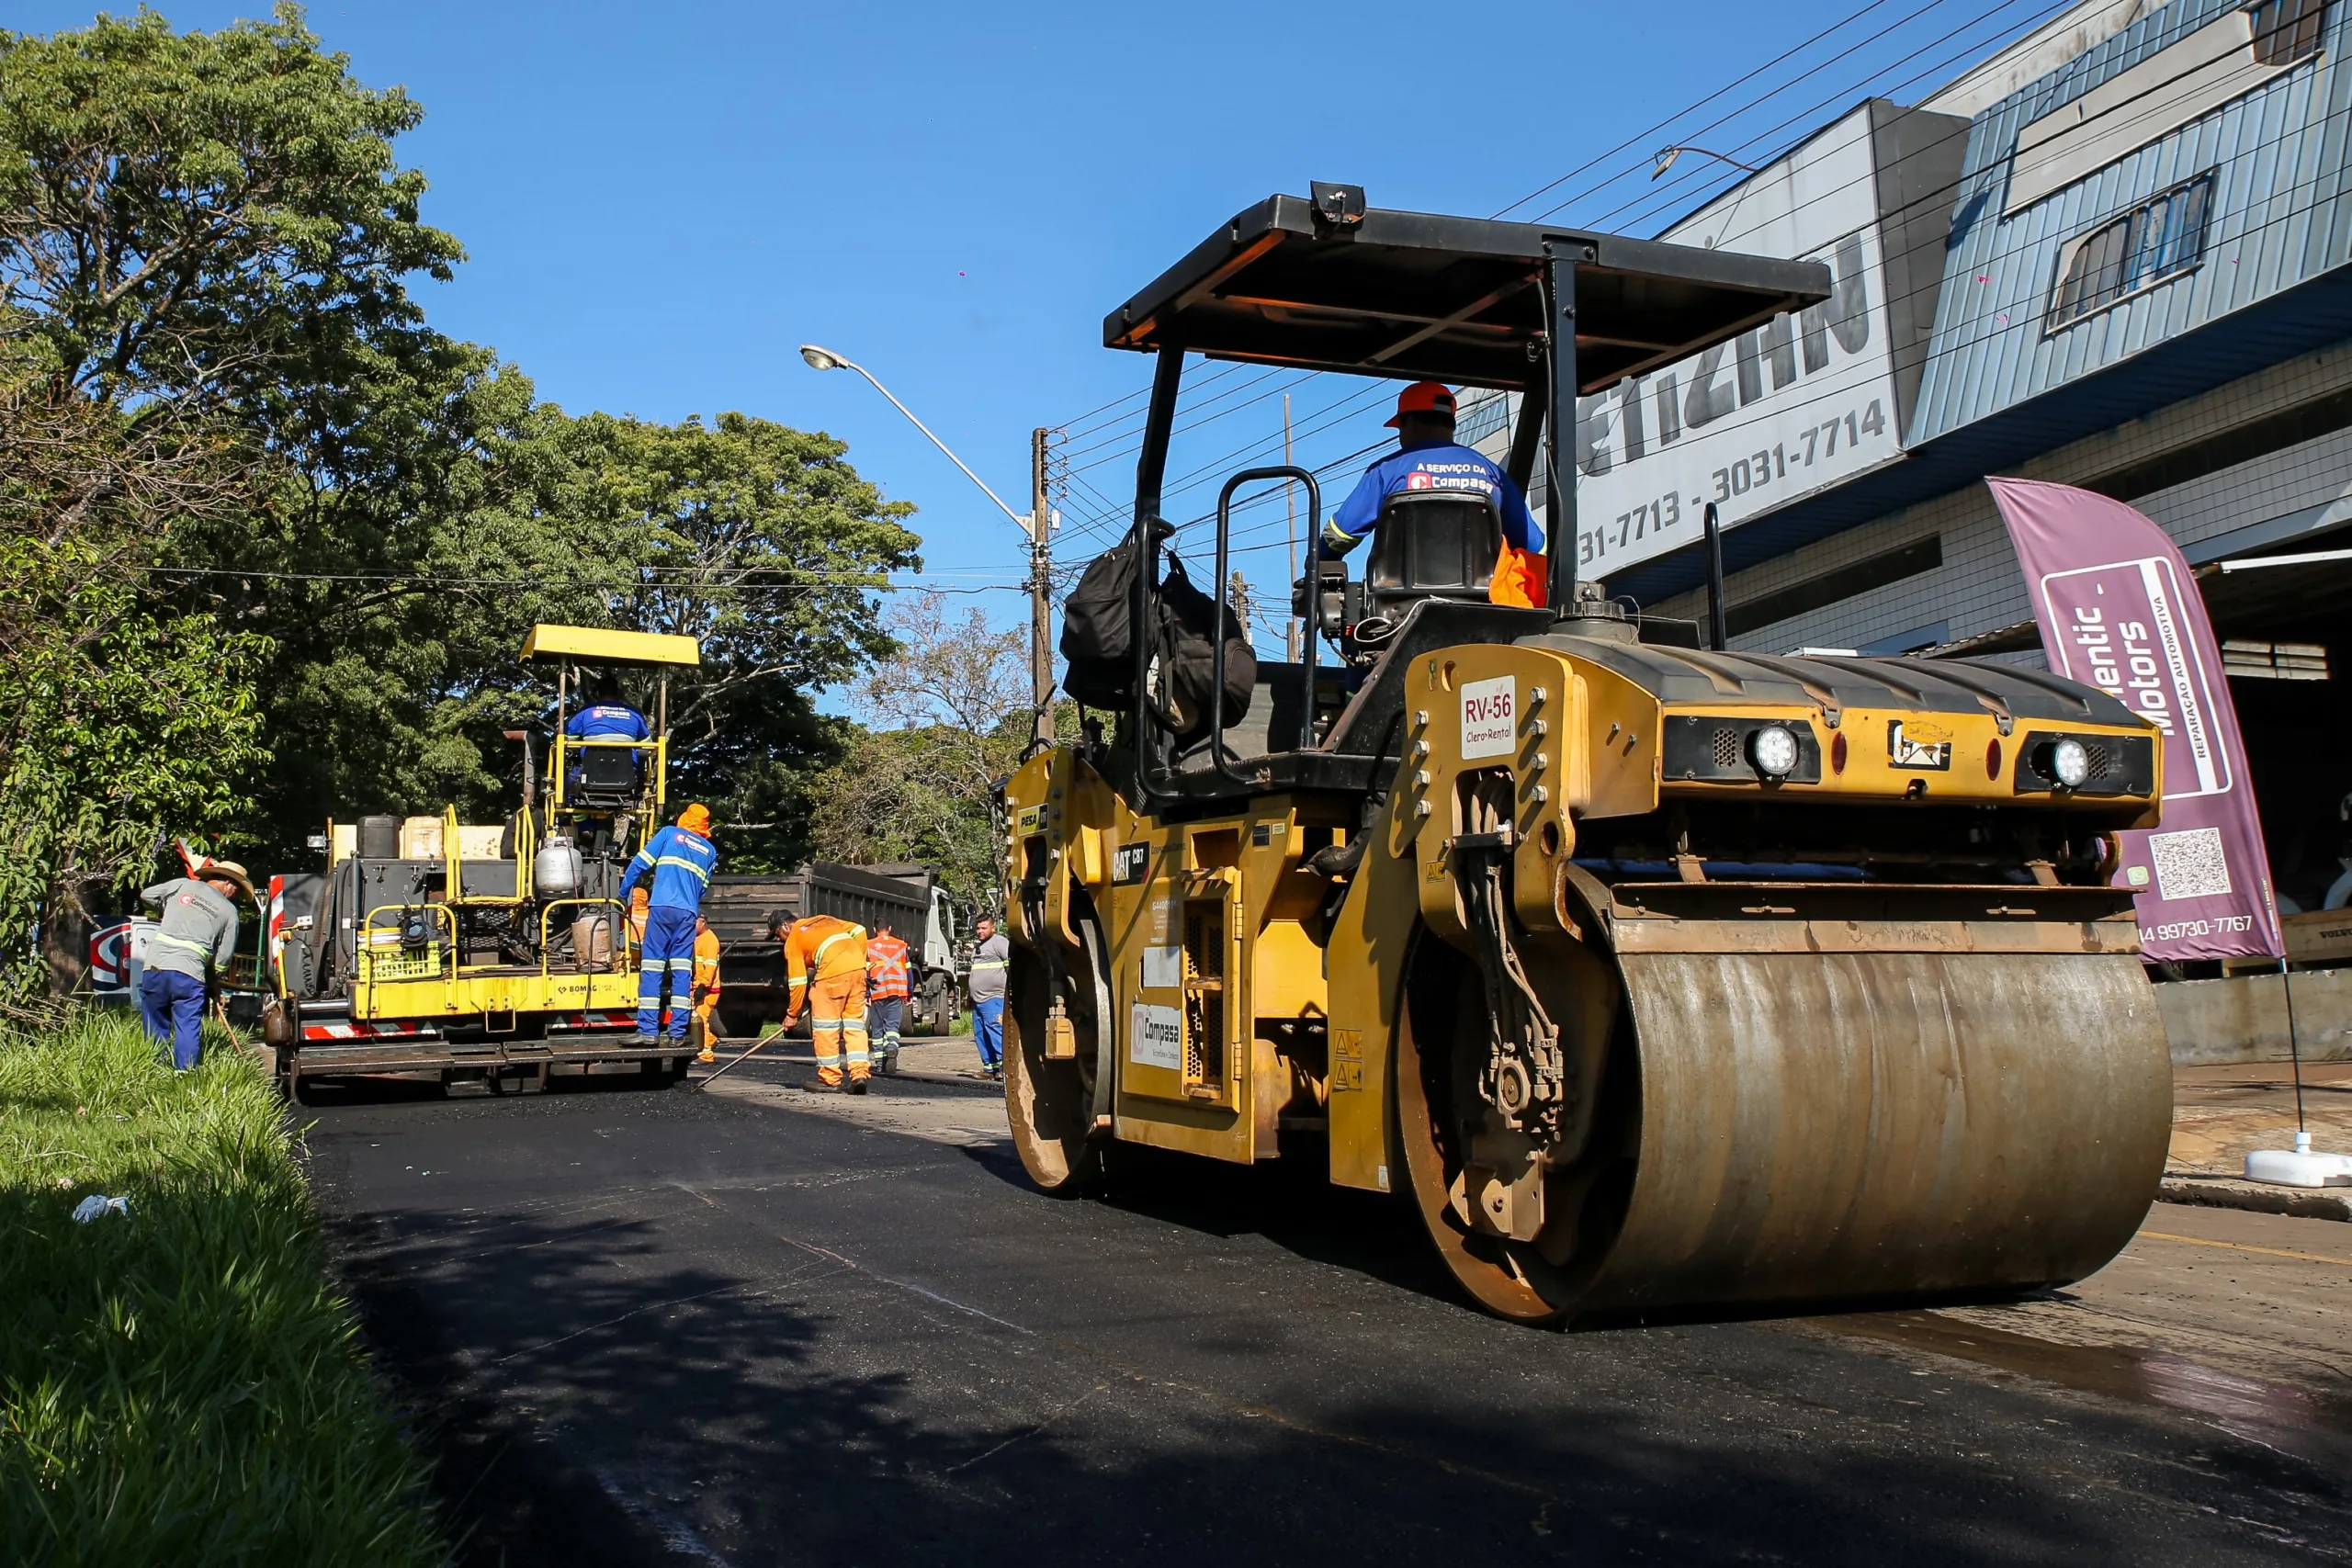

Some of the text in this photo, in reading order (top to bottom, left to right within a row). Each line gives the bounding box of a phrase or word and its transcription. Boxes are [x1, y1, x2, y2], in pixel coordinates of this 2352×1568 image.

[1713, 398, 1885, 503] 3031-7714
[1417, 463, 1487, 476] A SERVIÇO DA
[1431, 476, 1493, 494] Compasa
[2154, 597, 2184, 679] AUTOMOTIVA
[2072, 607, 2128, 706] entic
[2119, 621, 2176, 736] Motors
[1465, 693, 1511, 724] RV-56
[1021, 814, 1036, 828] PESA
[1113, 850, 1131, 881] CAT
[1132, 848, 1144, 863] CB7
[190, 897, 219, 919] Compasa
[2157, 915, 2253, 941] 99730-7767
[1145, 1017, 1179, 1046] Compasa
